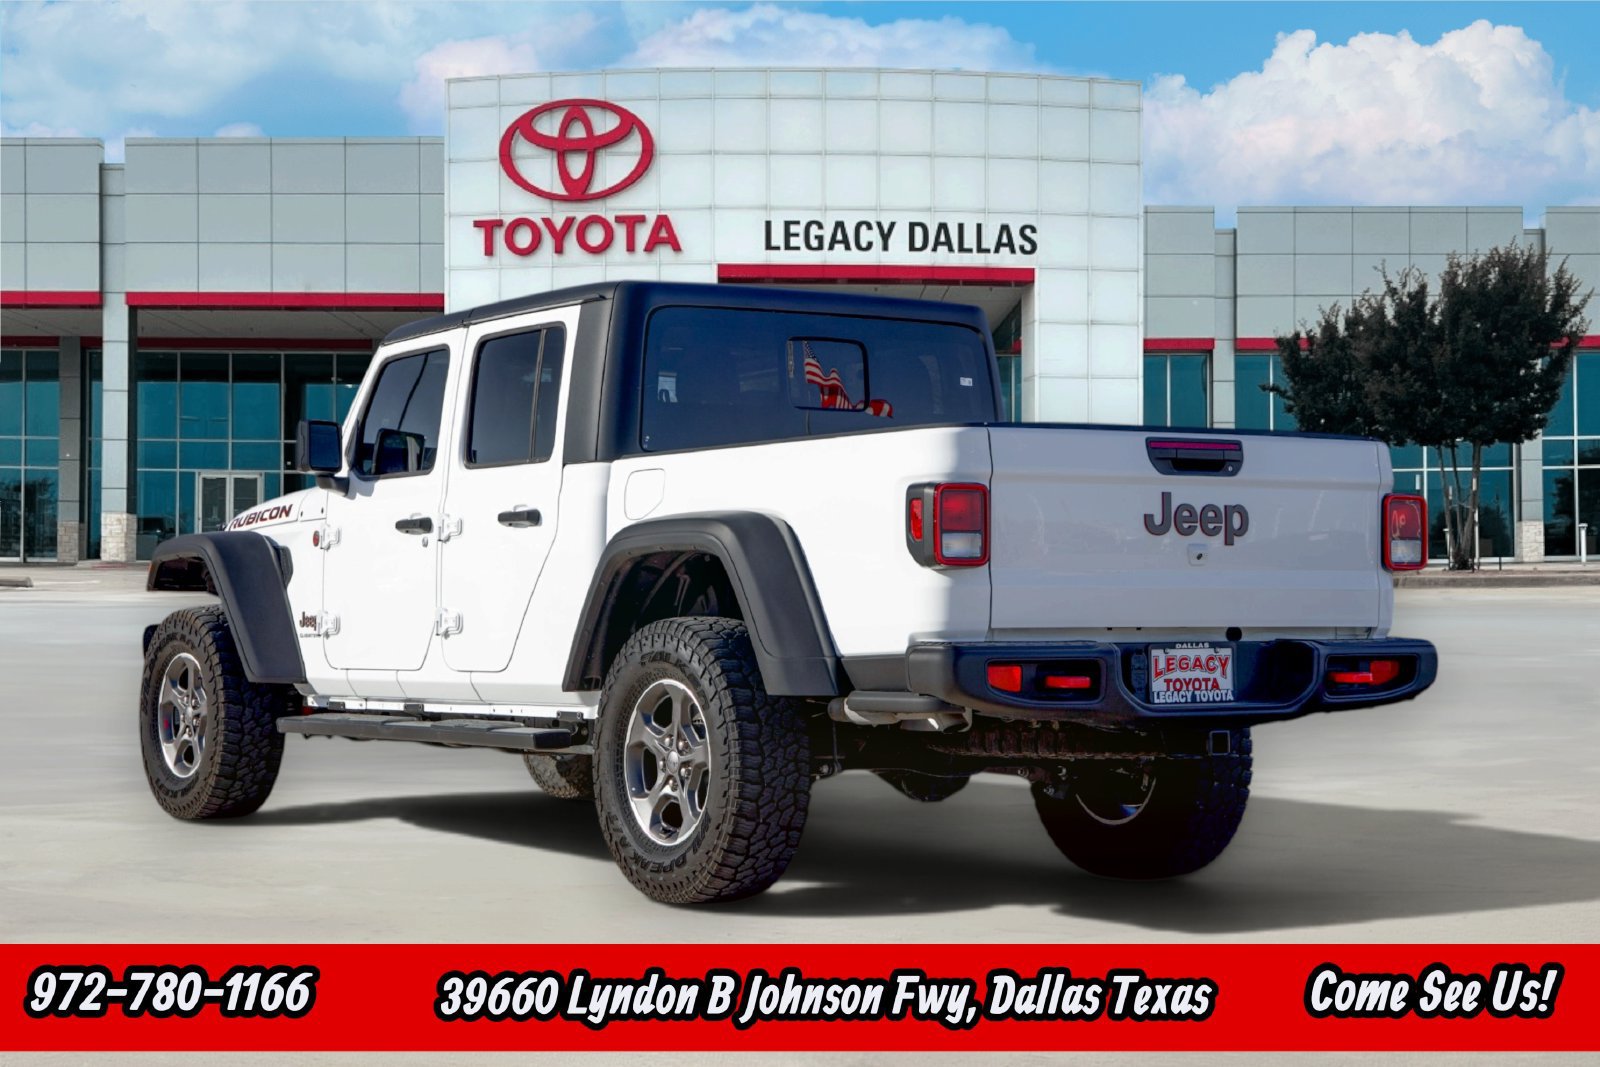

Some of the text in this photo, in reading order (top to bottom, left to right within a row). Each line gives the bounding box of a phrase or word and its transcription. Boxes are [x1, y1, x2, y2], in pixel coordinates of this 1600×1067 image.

[473, 214, 682, 256] TOYOTA
[764, 220, 1038, 256] LEGACY DALLAS
[229, 504, 293, 531] RUBICON
[1144, 491, 1249, 546] Jeep
[1153, 655, 1230, 682] LEGACY
[1153, 689, 1234, 704] LEGACY TOYOTA
[1164, 677, 1220, 692] TOYOTA
